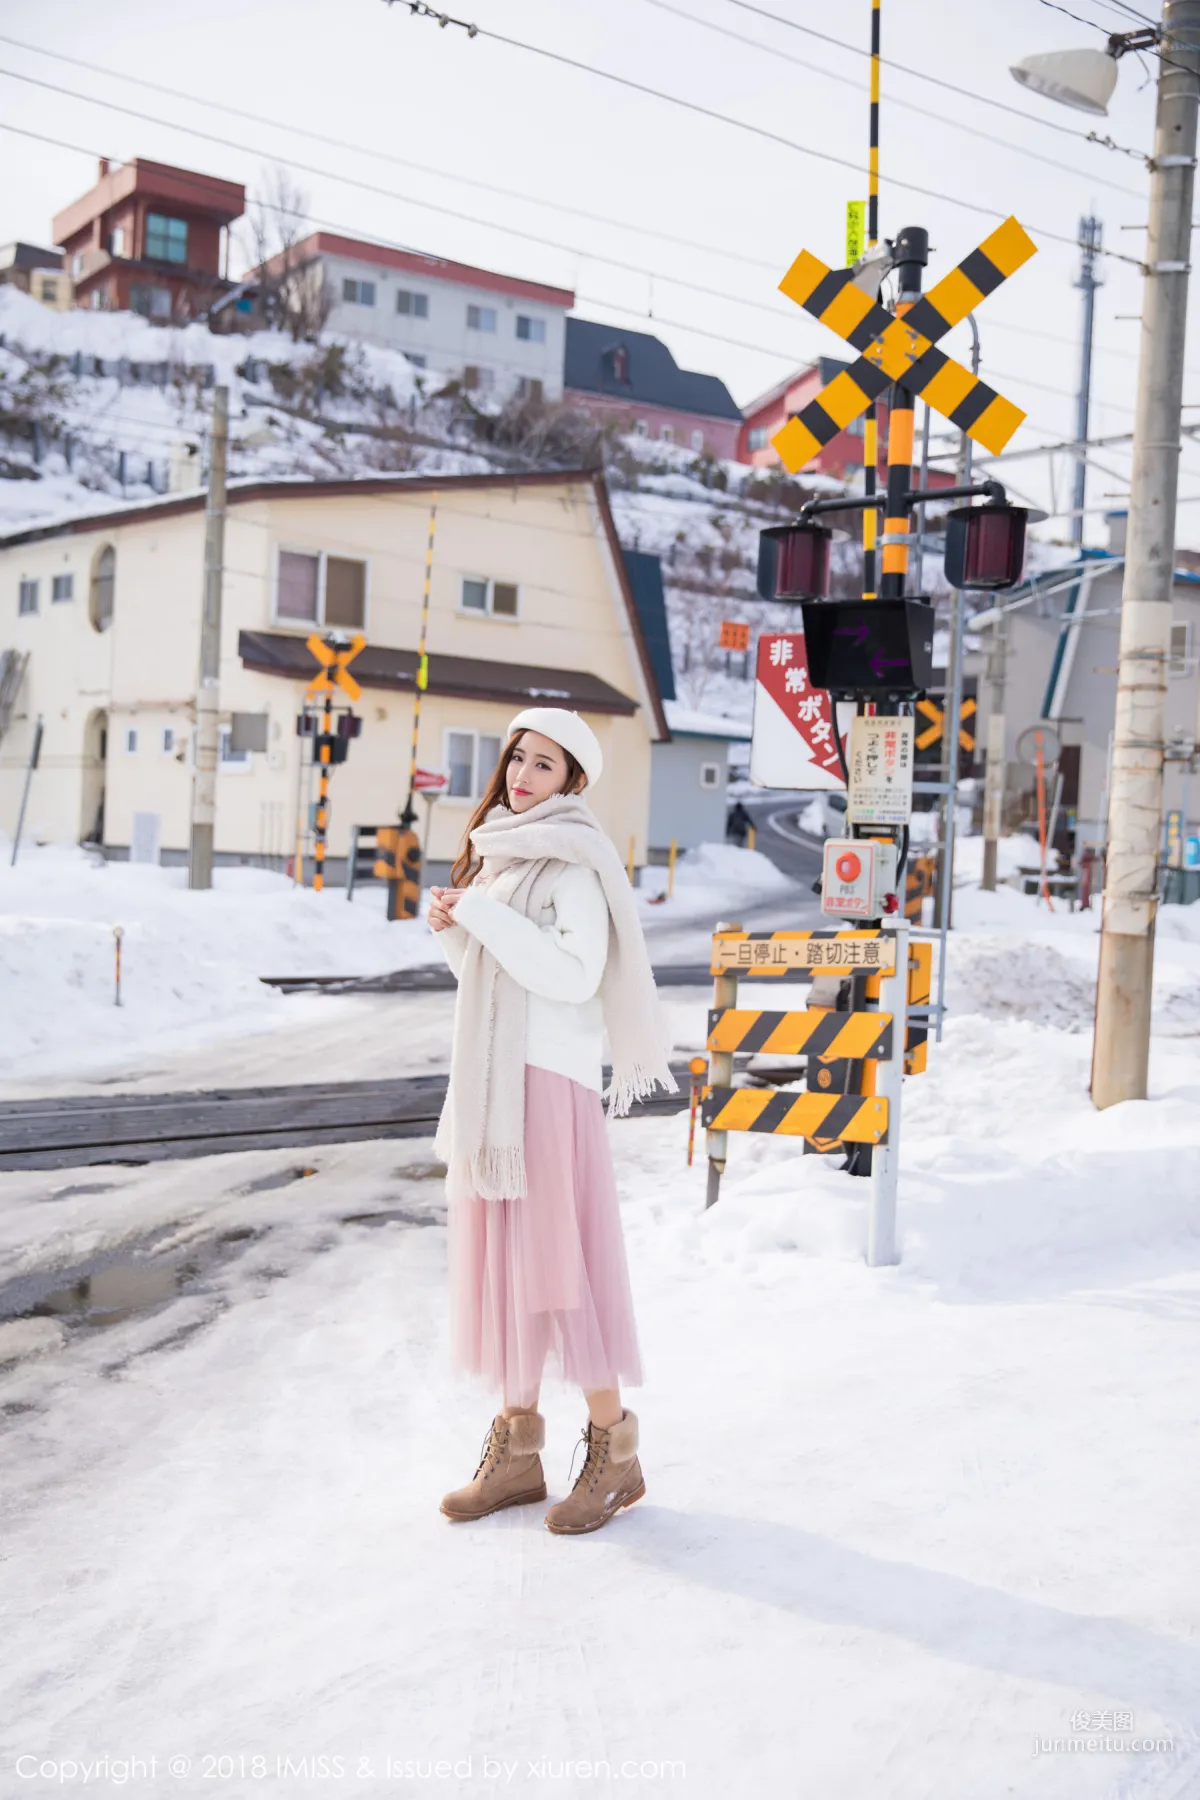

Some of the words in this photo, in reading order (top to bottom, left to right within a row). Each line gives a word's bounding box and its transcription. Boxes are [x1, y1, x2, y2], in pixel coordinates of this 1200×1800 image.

[769, 639, 840, 767] 非常ボタン
